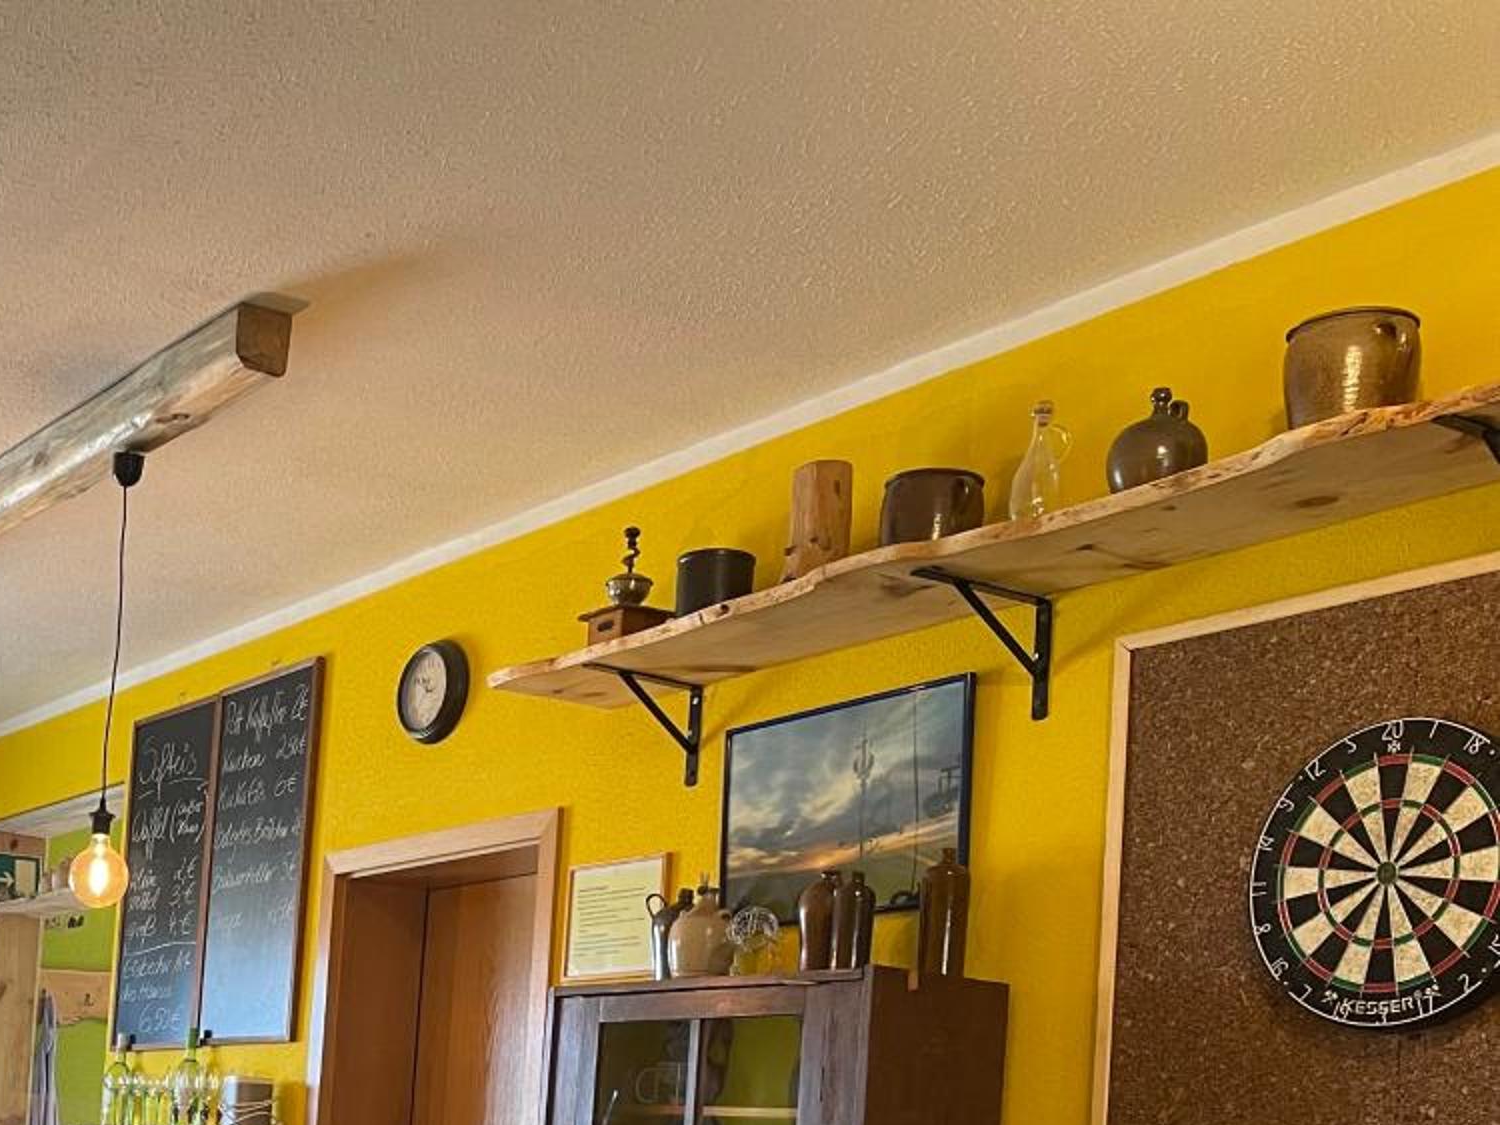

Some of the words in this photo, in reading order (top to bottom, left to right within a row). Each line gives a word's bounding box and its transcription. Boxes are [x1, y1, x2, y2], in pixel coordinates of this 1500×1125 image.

[1381, 721, 1404, 741] 20
[1463, 734, 1485, 755] 18
[1304, 760, 1327, 781] 12
[1254, 922, 1271, 936] 8
[1344, 996, 1414, 1014] KESSER
